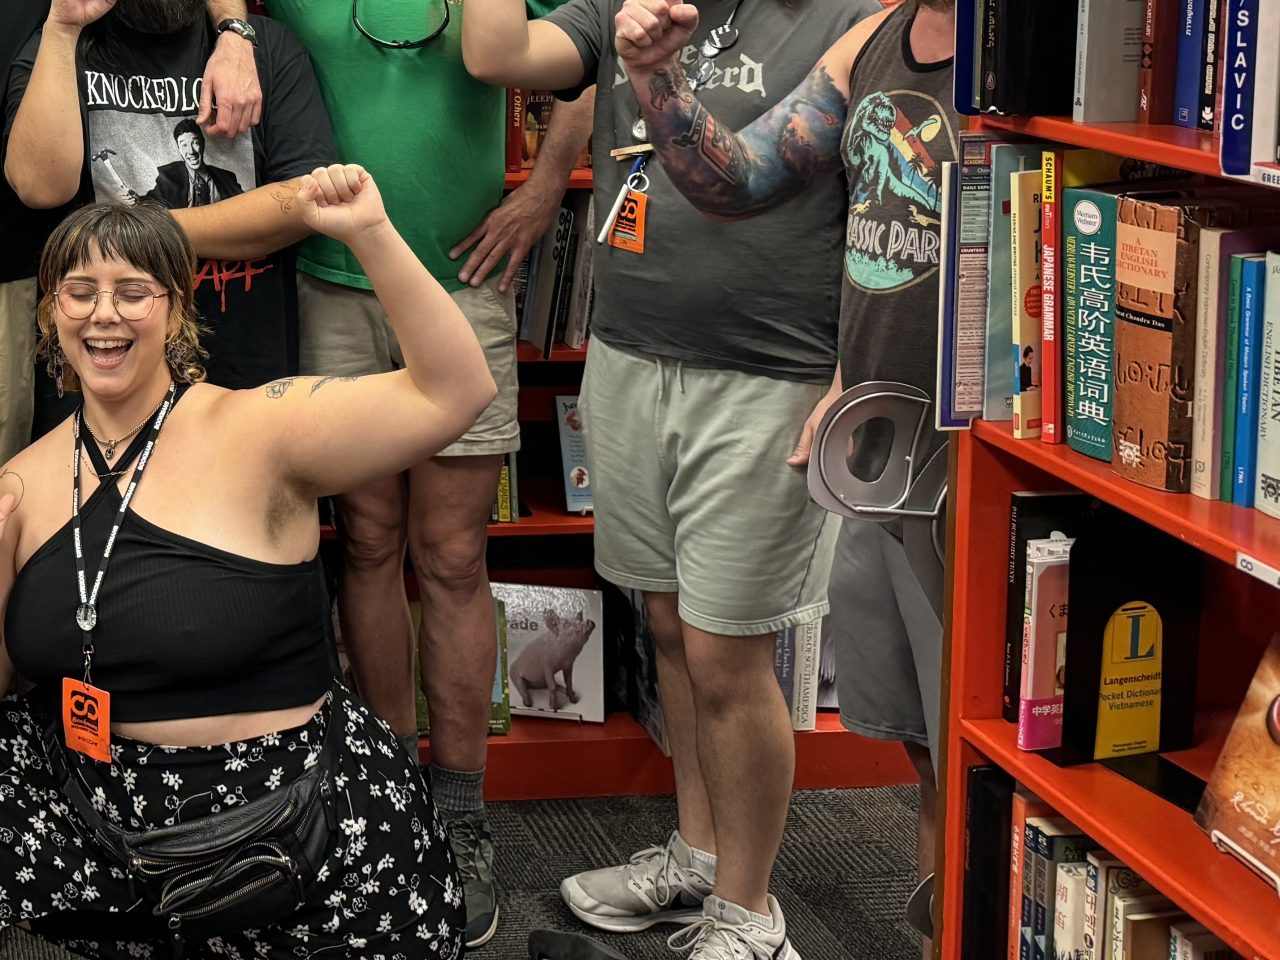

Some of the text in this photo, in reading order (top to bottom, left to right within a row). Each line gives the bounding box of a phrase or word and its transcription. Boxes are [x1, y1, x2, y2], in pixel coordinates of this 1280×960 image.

[84, 70, 180, 112] KNOCKED
[513, 95, 522, 128] Others
[1044, 156, 1053, 201] SCHAUM'S
[1120, 253, 1159, 268] ENGLISH
[1121, 243, 1159, 259] TIBETAN
[1042, 243, 1055, 342] JAPANESE GRAMMAR
[1076, 241, 1113, 427] 韦氏高阶英语词典
[1125, 311, 1165, 329] Chandra Das
[1259, 321, 1274, 441] ENGLISH DICTIONARY
[153, 400, 171, 431] BOOKMANS
[137, 440, 154, 472] BOOKMANS
[119, 481, 137, 513] BOOKMANS
[103, 524, 119, 559] BOOKMANS
[89, 570, 105, 605] BOOKMANS
[1124, 614, 1156, 660] L
[1104, 672, 1162, 686] Langenscheidt
[1108, 699, 1154, 711] Vietnamese
